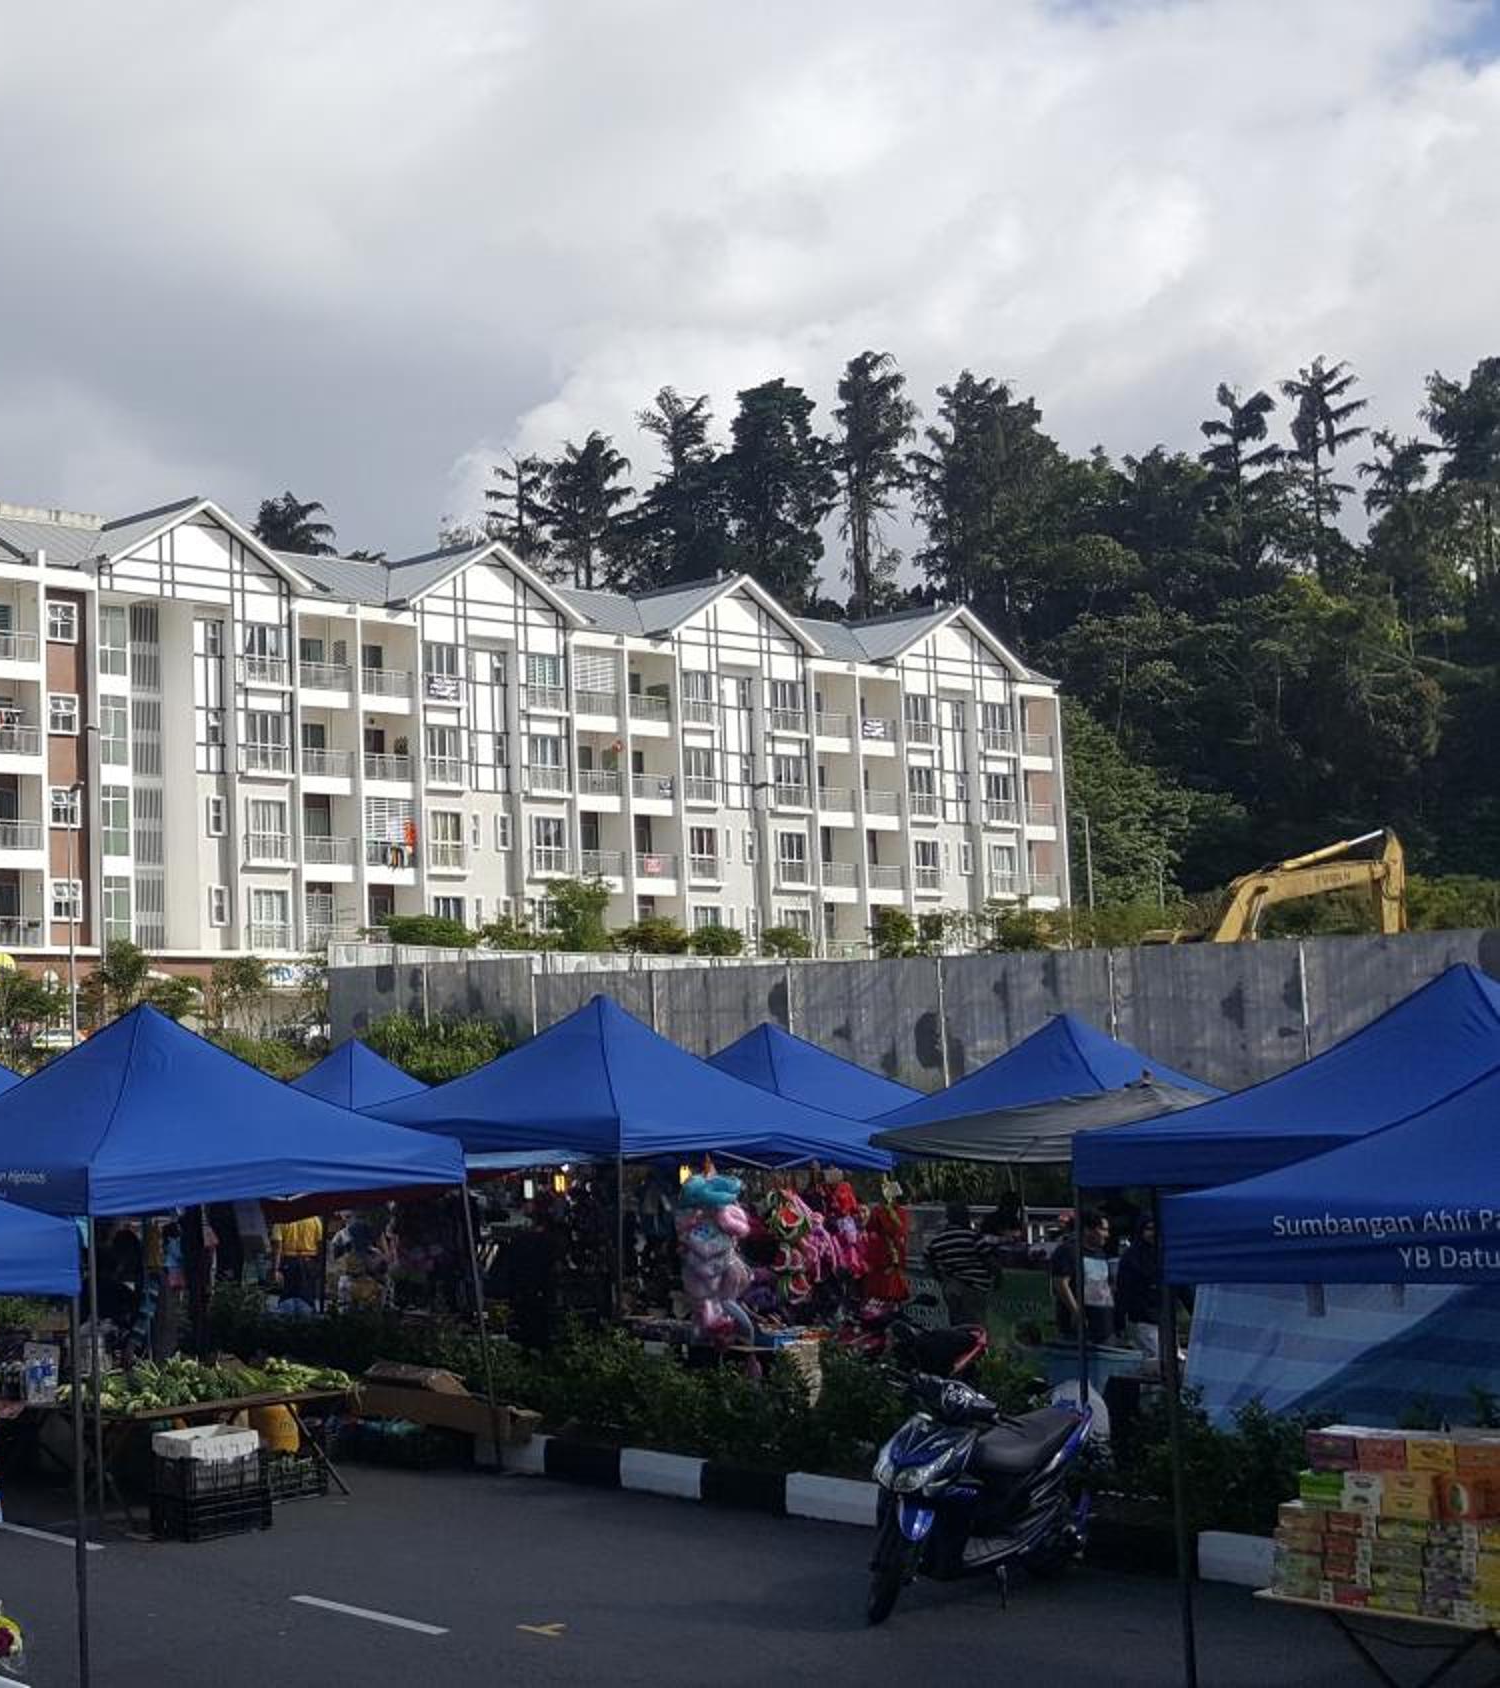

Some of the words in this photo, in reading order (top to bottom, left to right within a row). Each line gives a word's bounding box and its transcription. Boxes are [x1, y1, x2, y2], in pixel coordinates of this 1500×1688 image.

[1273, 1213, 1415, 1239] Sumbangan
[1423, 1209, 1471, 1233] Ahli
[1399, 1247, 1431, 1269] YB
[1439, 1246, 1500, 1269] Datu
